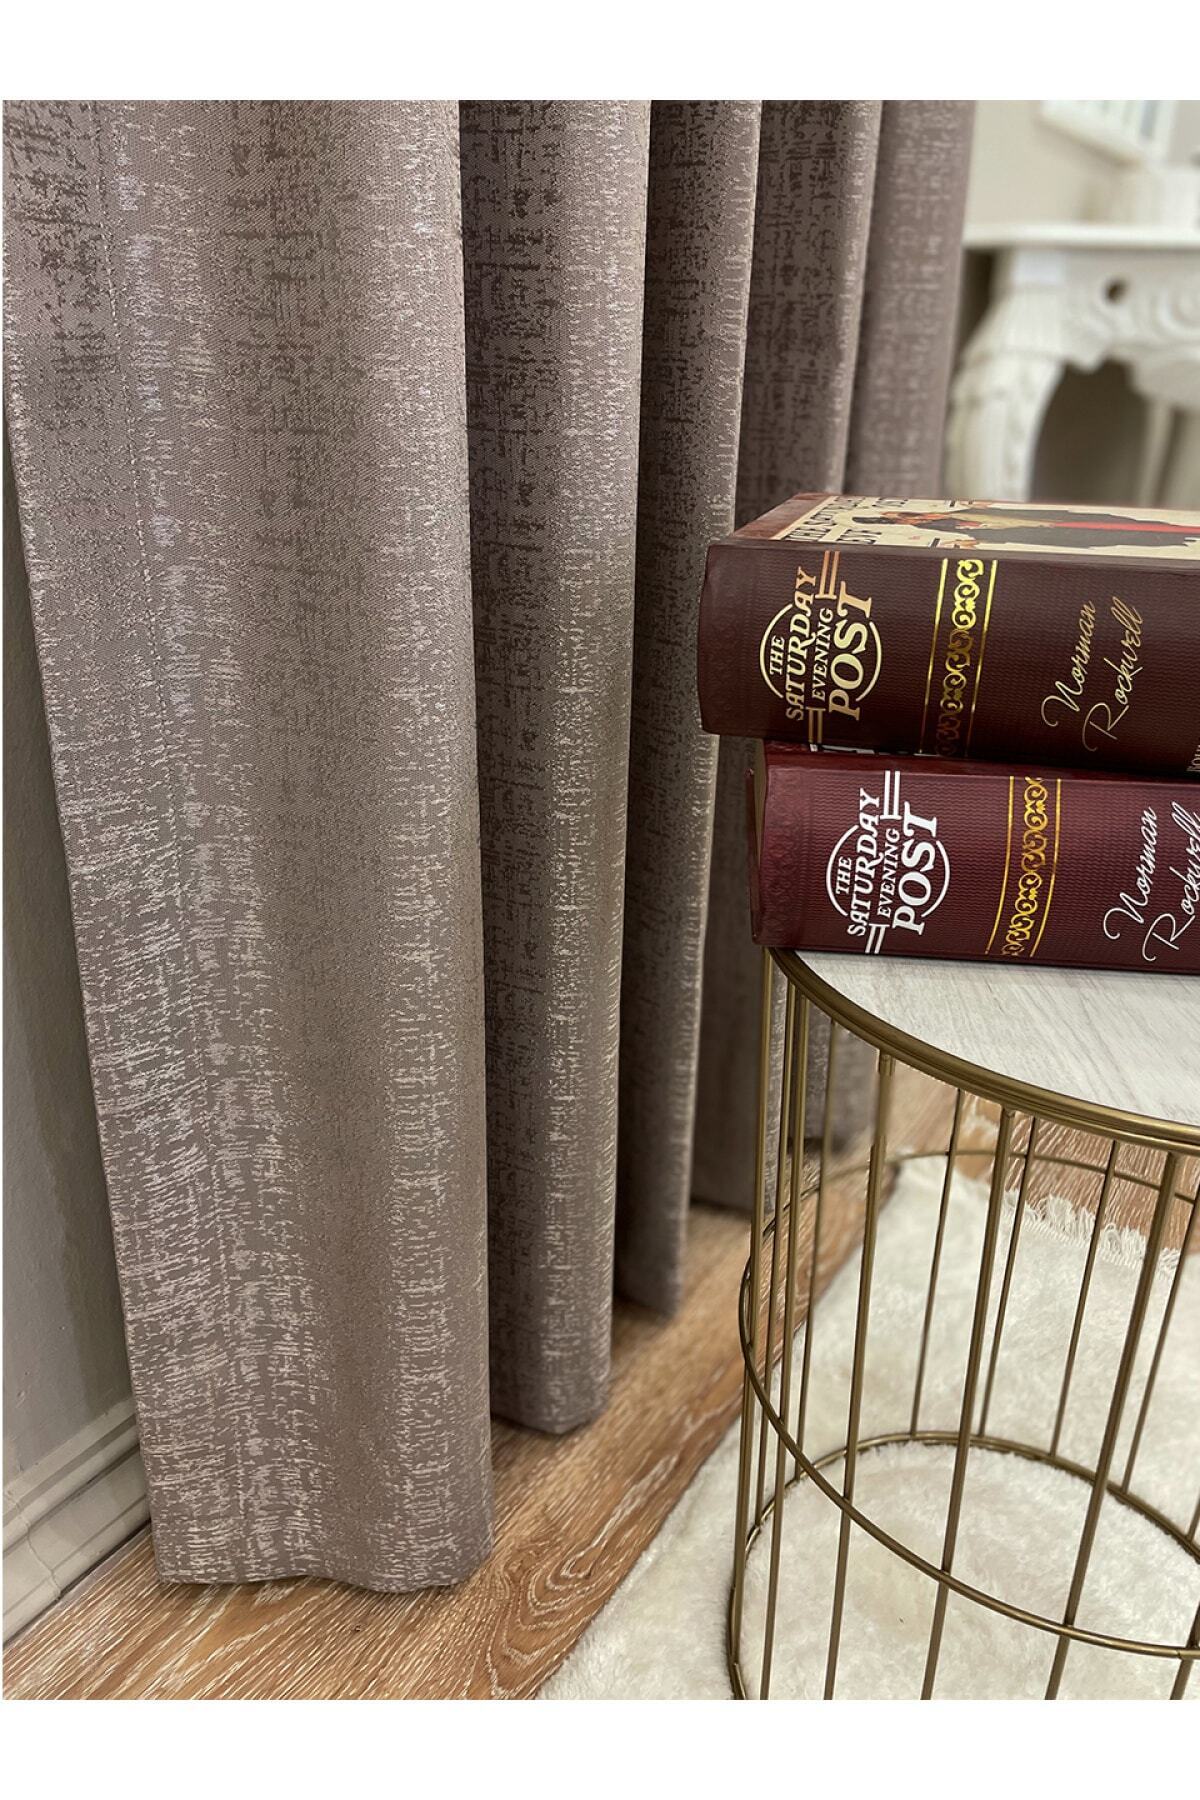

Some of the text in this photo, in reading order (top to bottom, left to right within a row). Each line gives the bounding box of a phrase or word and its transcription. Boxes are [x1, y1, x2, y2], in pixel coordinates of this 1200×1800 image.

[769, 635, 785, 675] THE
[785, 566, 817, 721] SATURDAY
[812, 607, 834, 702] EVENING
[828, 581, 872, 721] POST
[1041, 600, 1096, 727] Norman
[1082, 596, 1143, 751] Rockwell
[836, 856, 852, 894] THE
[847, 788, 884, 936] SATURDAY
[877, 828, 900, 918] EVENING
[892, 801, 937, 935] POST
[1103, 806, 1157, 939] Norman
